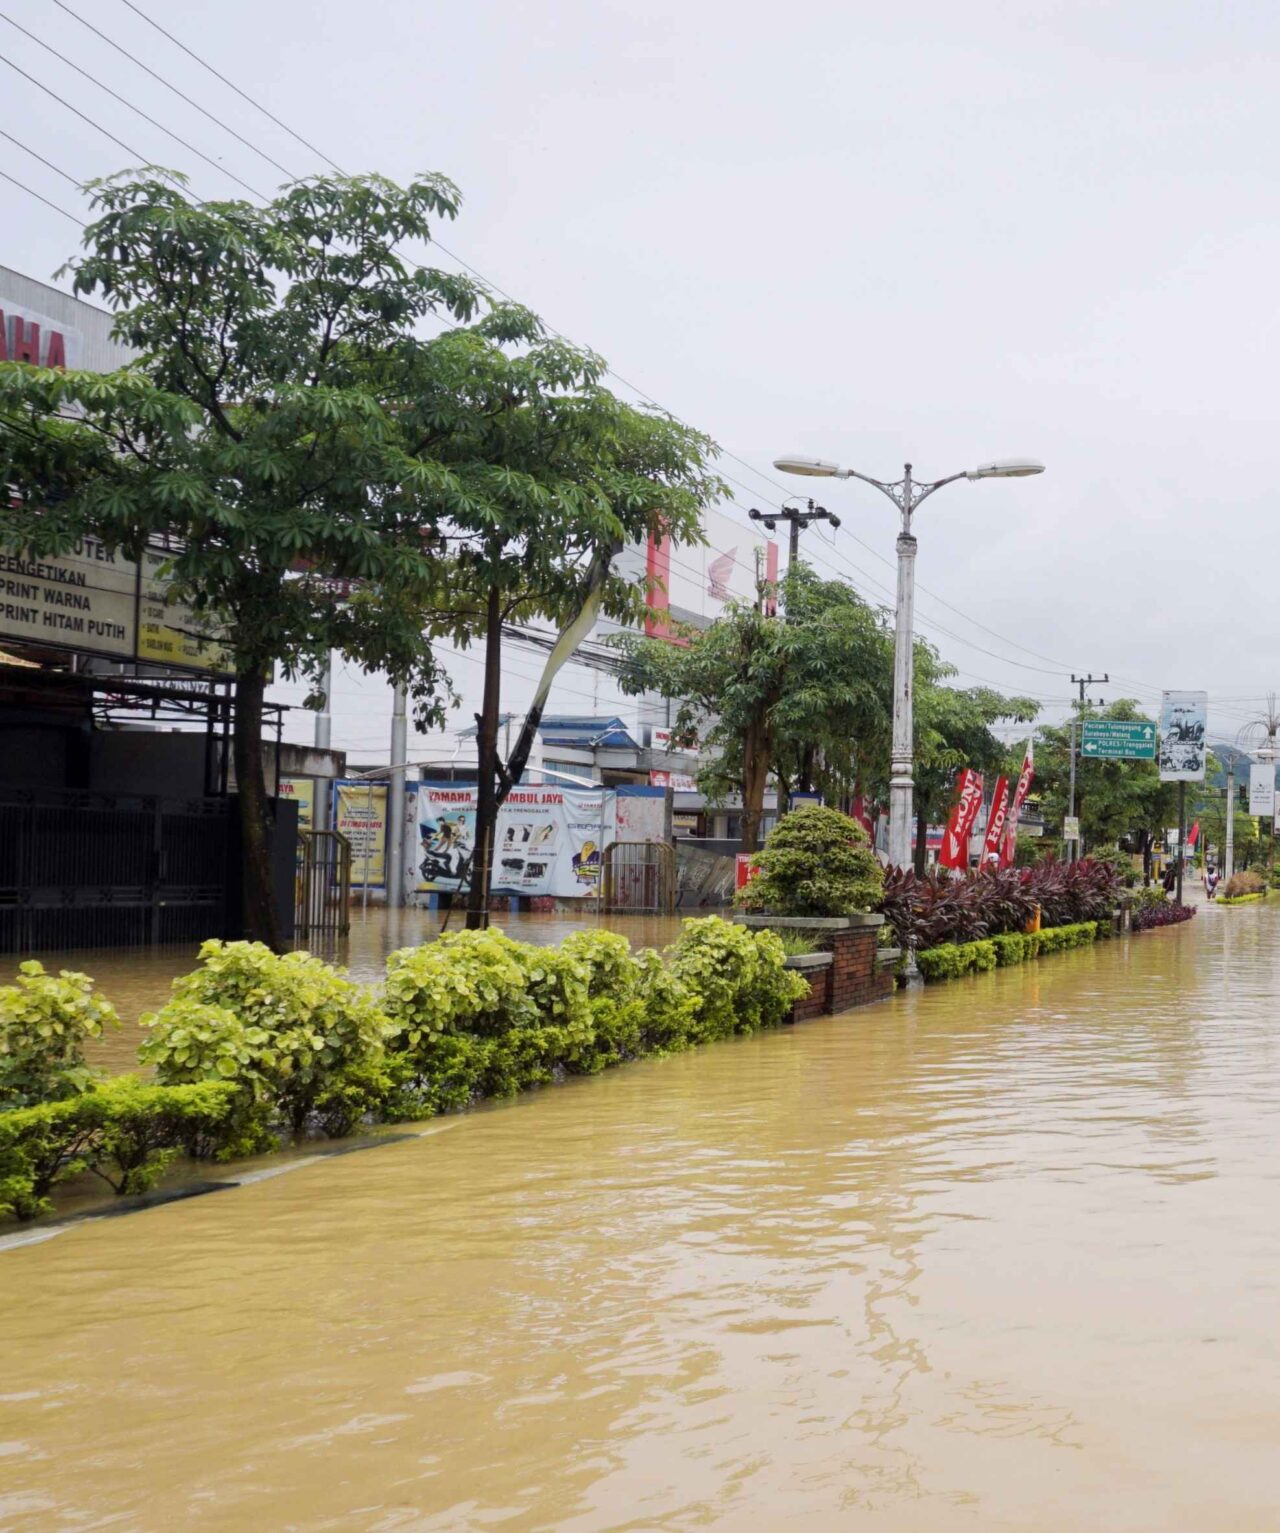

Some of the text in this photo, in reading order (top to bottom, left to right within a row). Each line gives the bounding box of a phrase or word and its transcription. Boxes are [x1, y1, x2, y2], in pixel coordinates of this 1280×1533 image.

[0, 555, 86, 587] PENGETIKAN
[0, 579, 91, 611] PRINT WARNA
[0, 603, 126, 640] PRINT HITAM PUTIH
[1125, 748, 1136, 756] Bus
[428, 791, 564, 805] YAMAHA IMBUL JAYA
